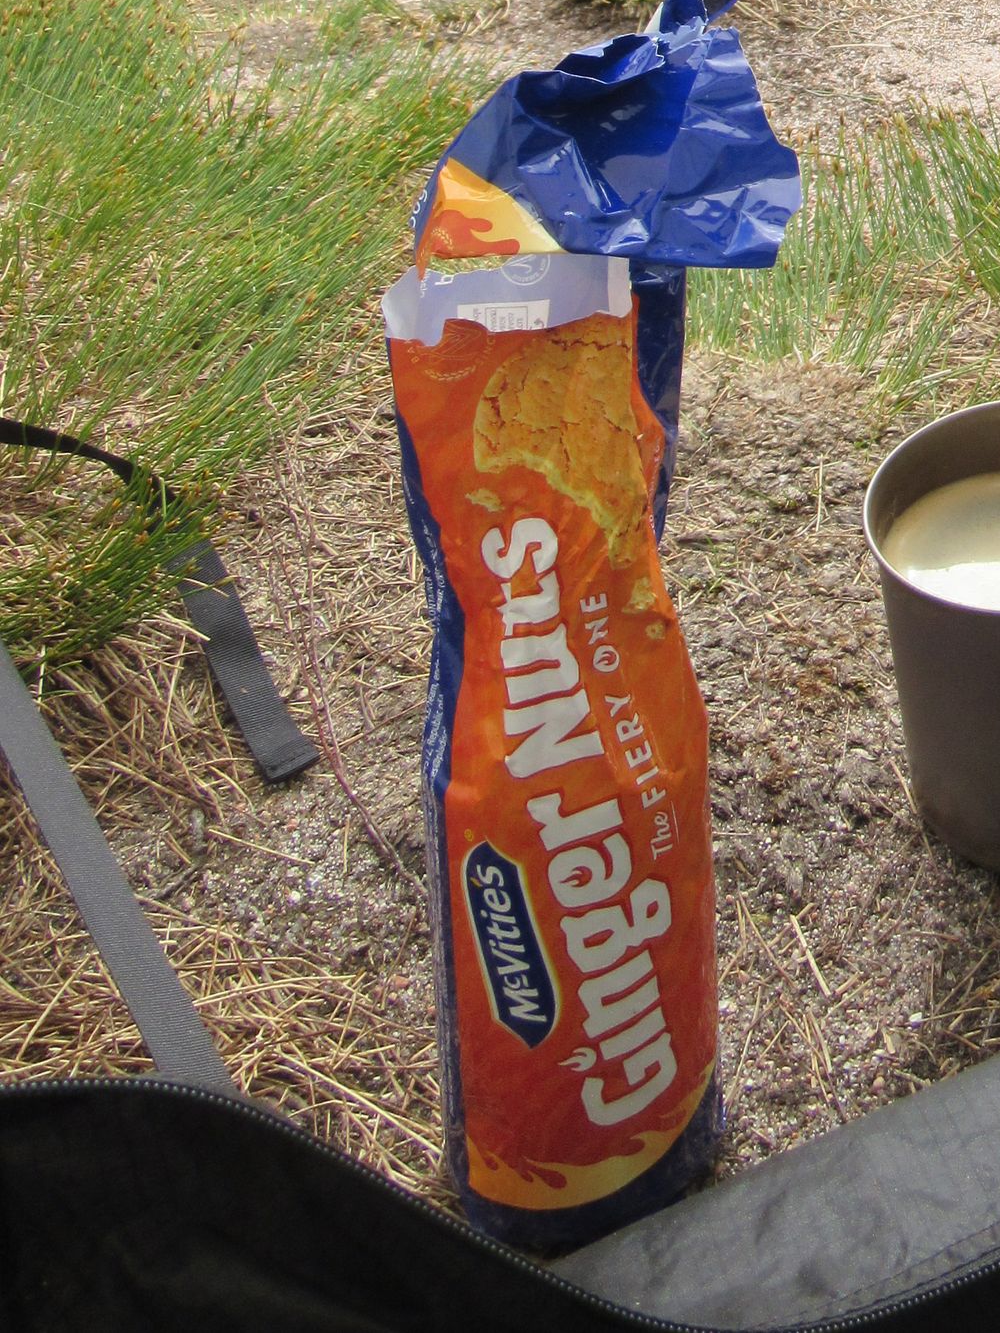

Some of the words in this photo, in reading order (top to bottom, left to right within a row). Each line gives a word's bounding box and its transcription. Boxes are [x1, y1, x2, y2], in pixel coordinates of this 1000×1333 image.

[481, 517, 605, 779] Nuts
[579, 592, 620, 673] ONE
[604, 693, 667, 809] FIERY
[652, 810, 674, 861] The
[471, 863, 548, 1023] McVitie's
[526, 792, 678, 1127] Ginger
